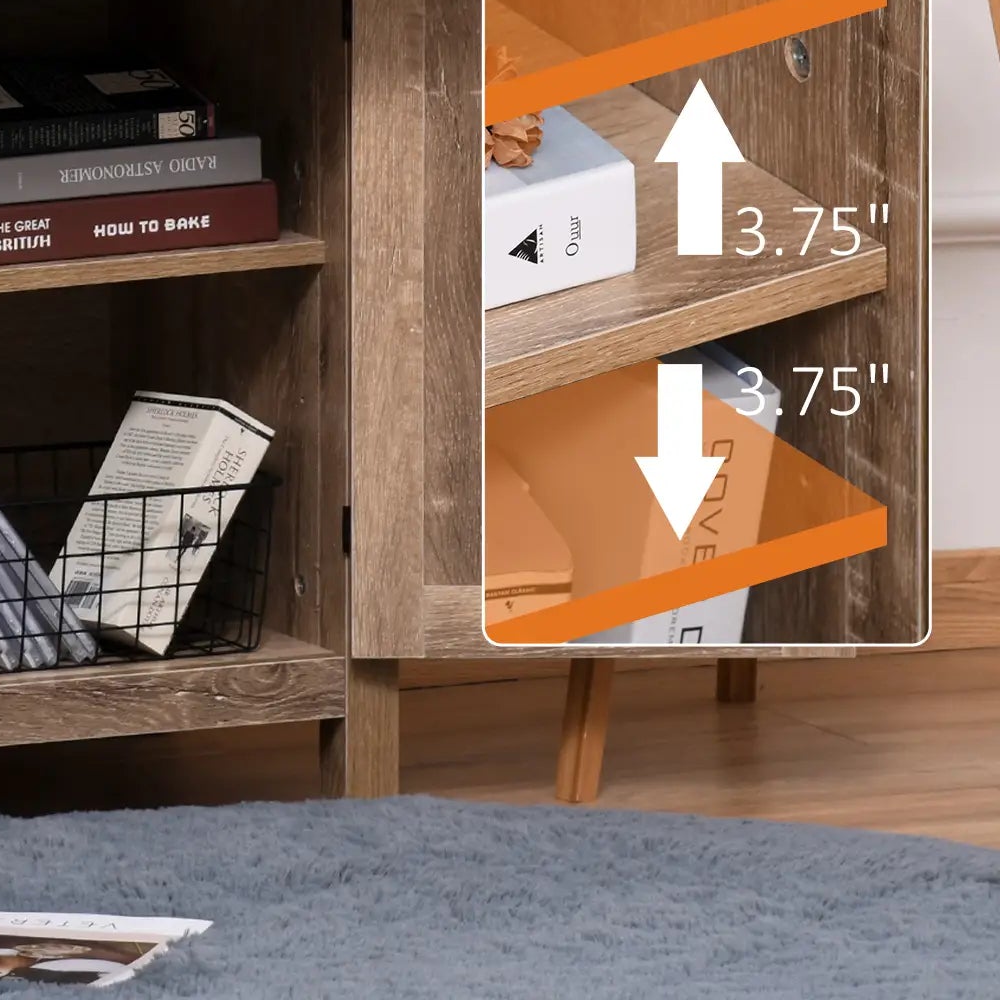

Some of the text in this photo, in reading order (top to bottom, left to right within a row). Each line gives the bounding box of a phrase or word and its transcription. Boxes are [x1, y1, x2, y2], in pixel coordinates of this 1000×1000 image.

[59, 155, 217, 184] RADIO ASTRONOMER
[14, 217, 51, 233] GREAT
[93, 214, 210, 238] HOW TO BAKE
[564, 215, 582, 257] Ouur
[693, 439, 734, 566] COVE
